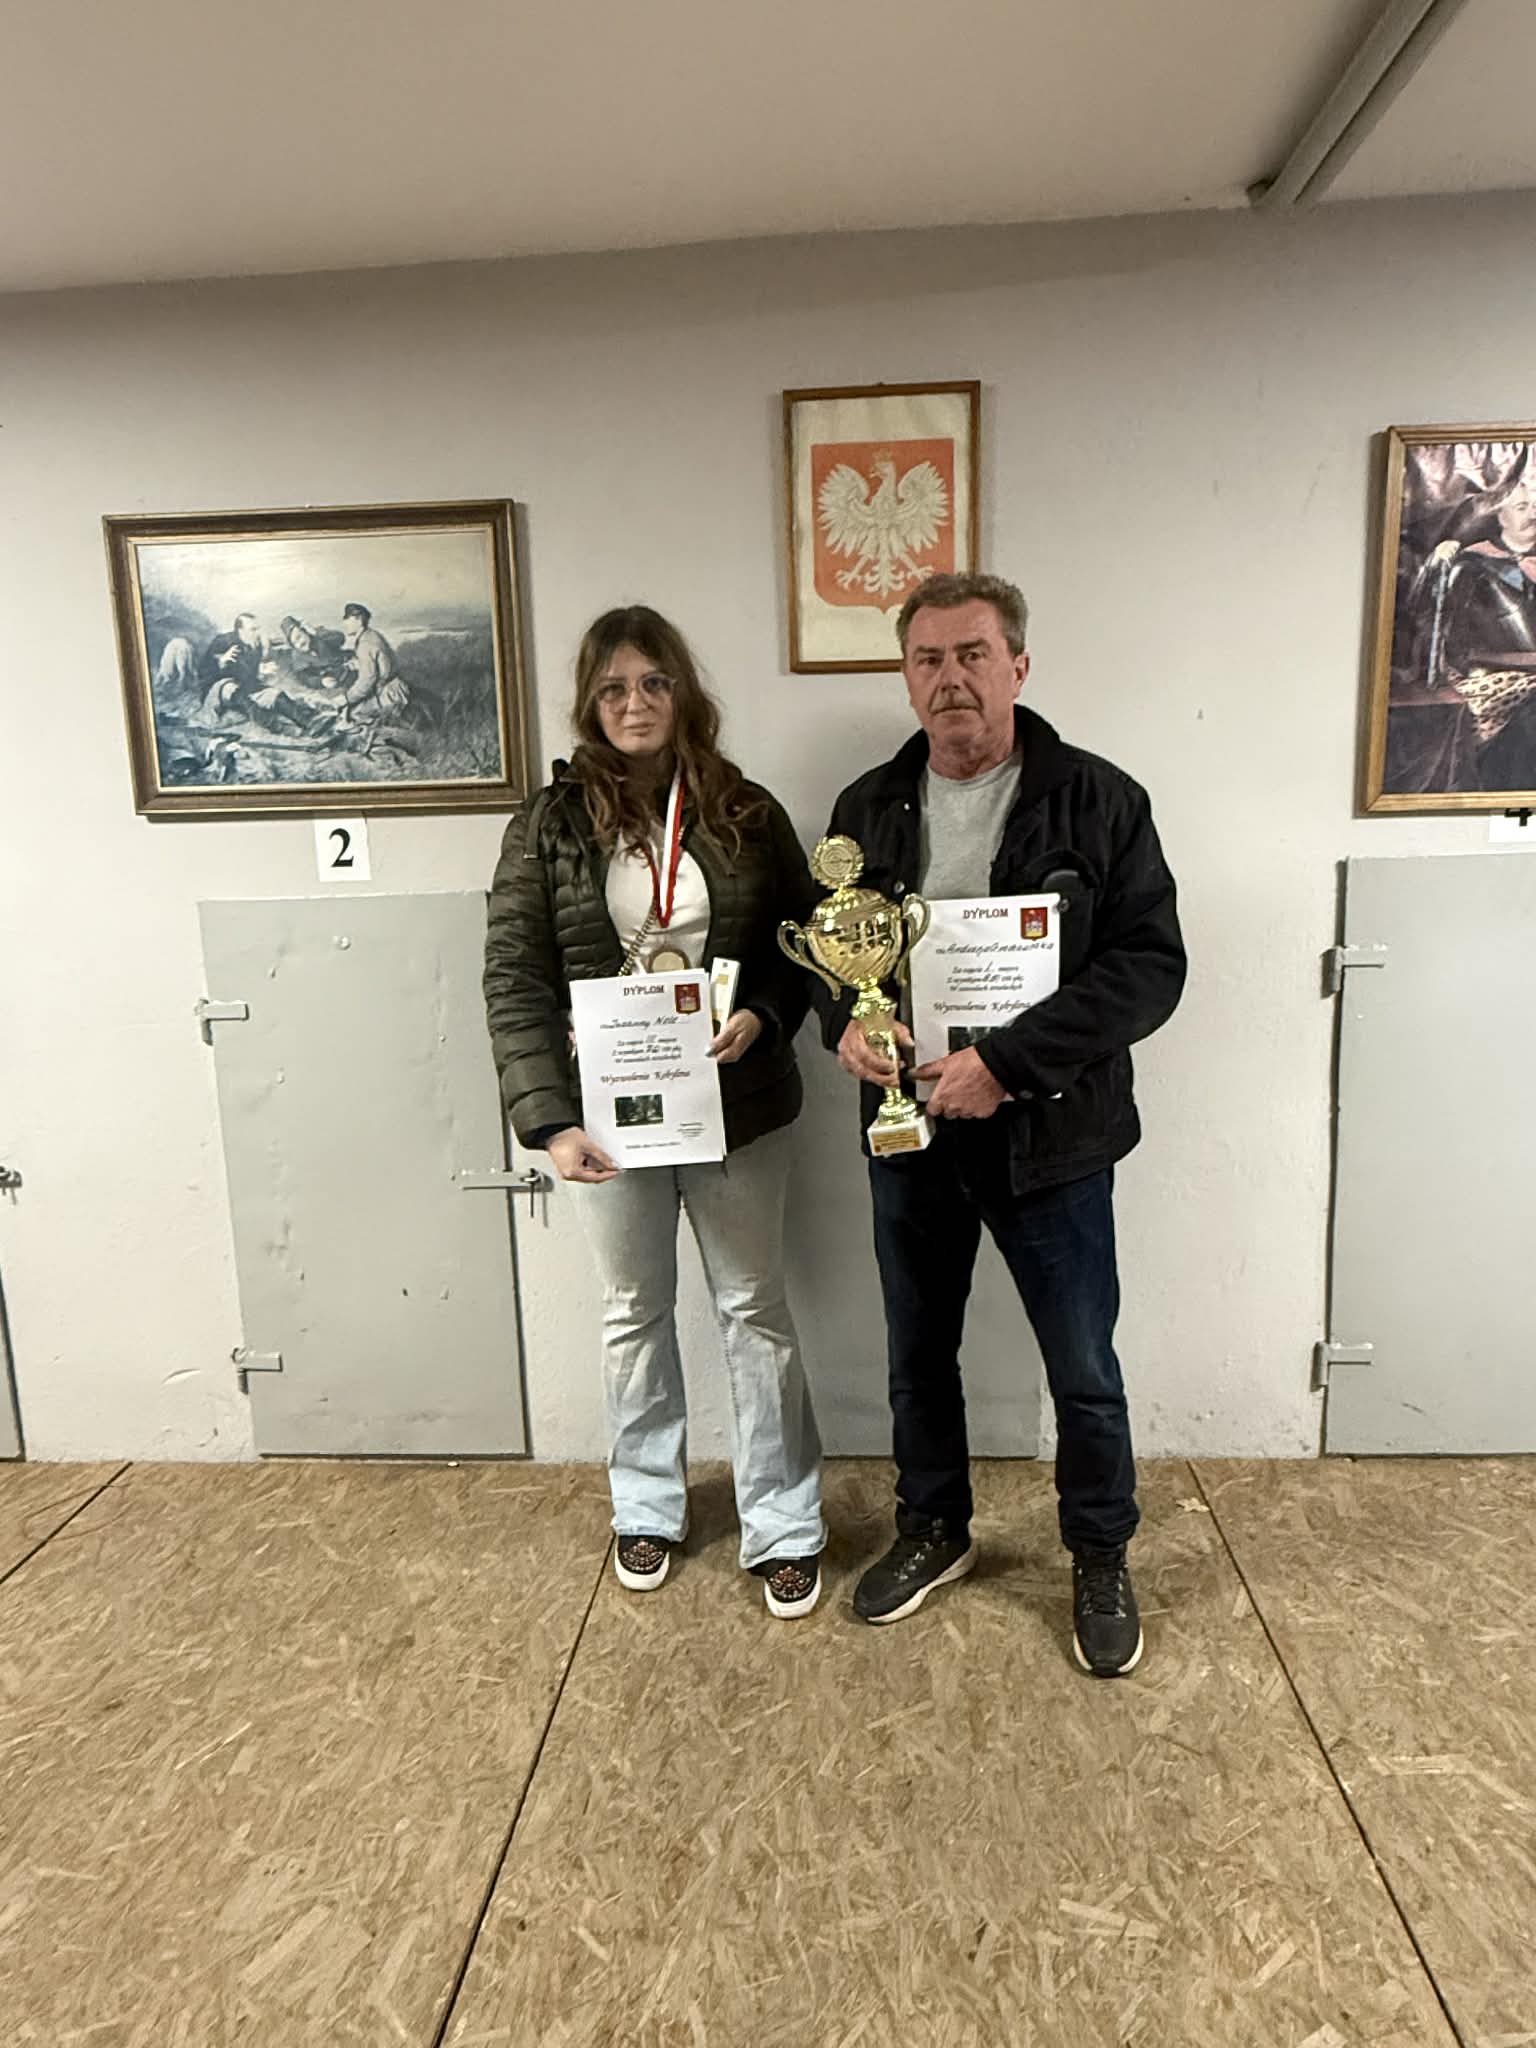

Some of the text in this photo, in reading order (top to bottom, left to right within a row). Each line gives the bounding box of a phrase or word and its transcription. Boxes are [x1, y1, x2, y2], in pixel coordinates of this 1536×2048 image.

[328, 827, 355, 869] 2
[963, 907, 1009, 919] DYPLOM
[623, 984, 665, 996] DYPLOM
